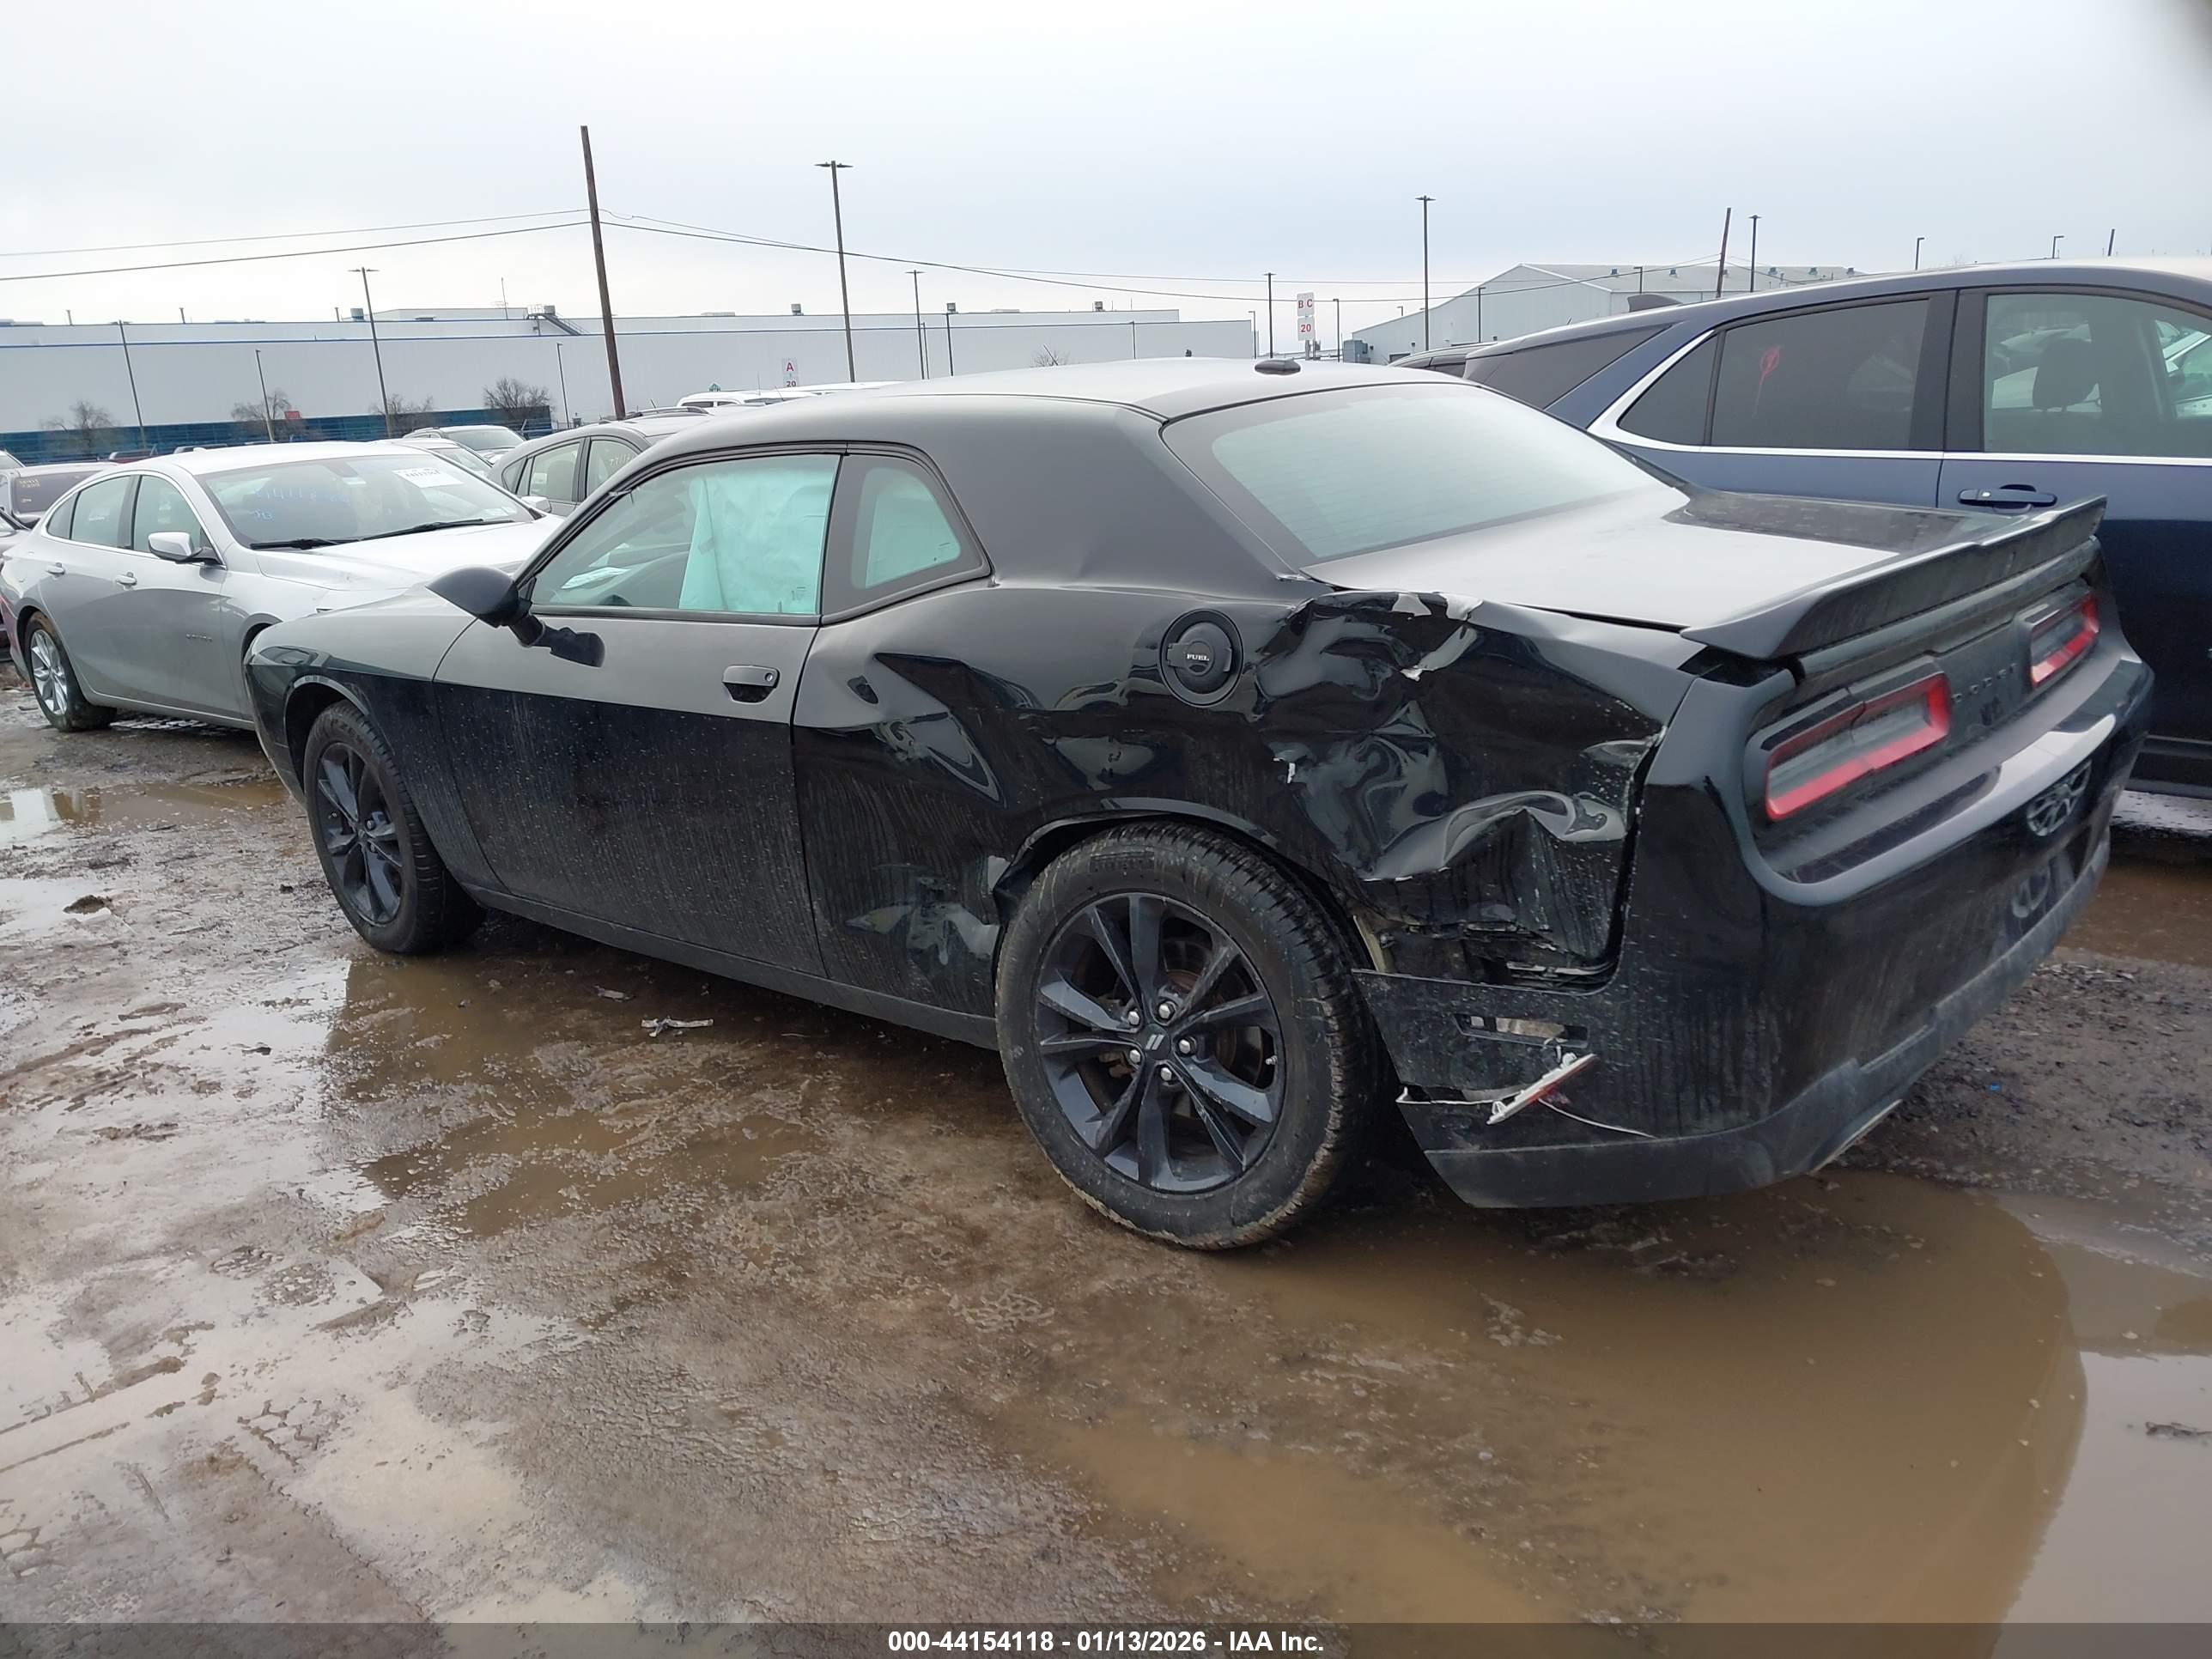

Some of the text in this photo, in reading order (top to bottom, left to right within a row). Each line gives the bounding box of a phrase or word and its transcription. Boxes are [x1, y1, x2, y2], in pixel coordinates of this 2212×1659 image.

[1298, 298, 1313, 309] B C
[1300, 323, 1312, 333] 20
[786, 362, 794, 372] A
